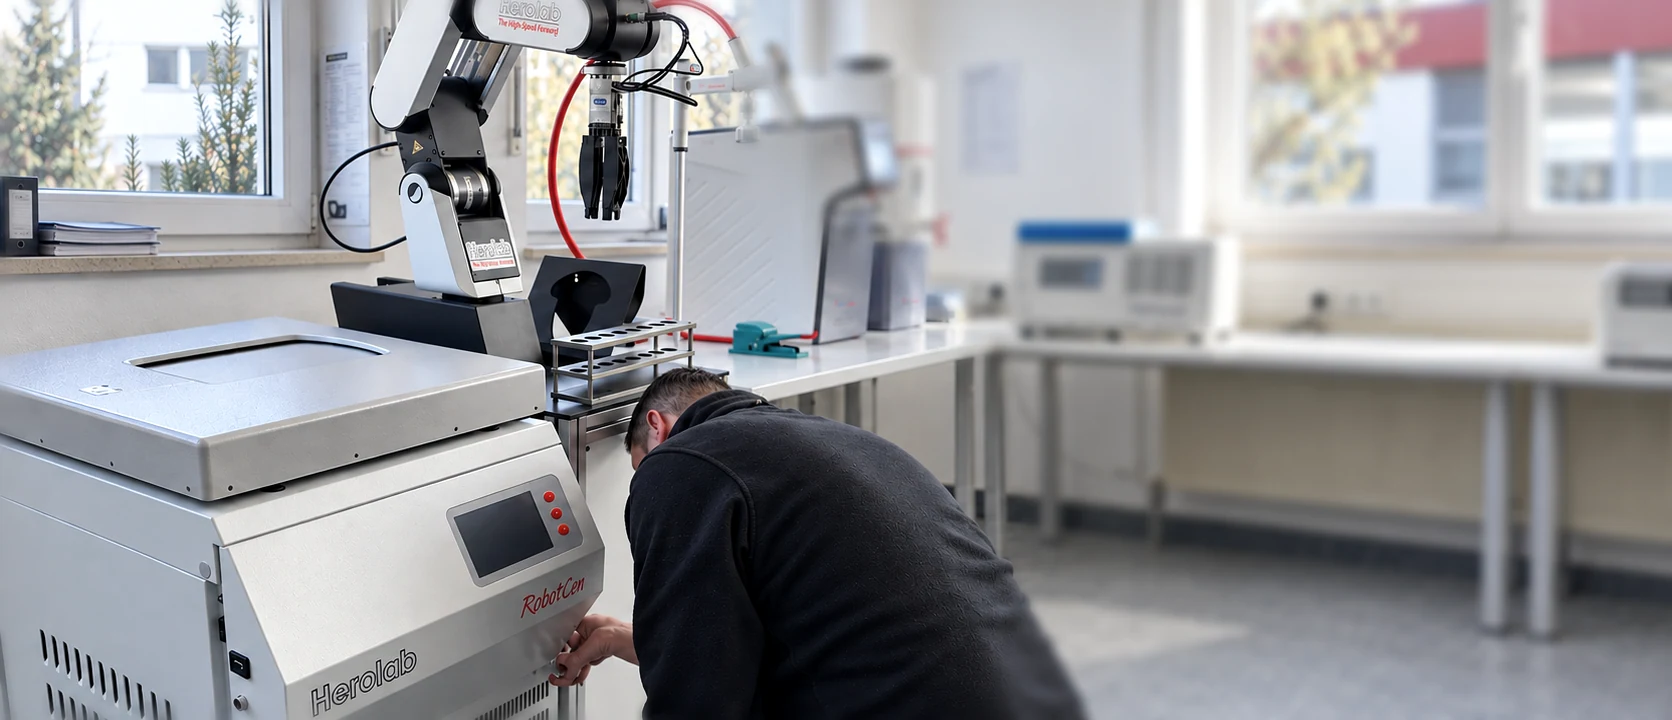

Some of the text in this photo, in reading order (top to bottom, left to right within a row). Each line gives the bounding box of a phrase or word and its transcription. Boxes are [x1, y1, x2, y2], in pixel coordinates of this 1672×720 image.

[499, 0, 562, 22] Herolab
[520, 577, 585, 619] RobotCen
[311, 649, 417, 717] Herolab
